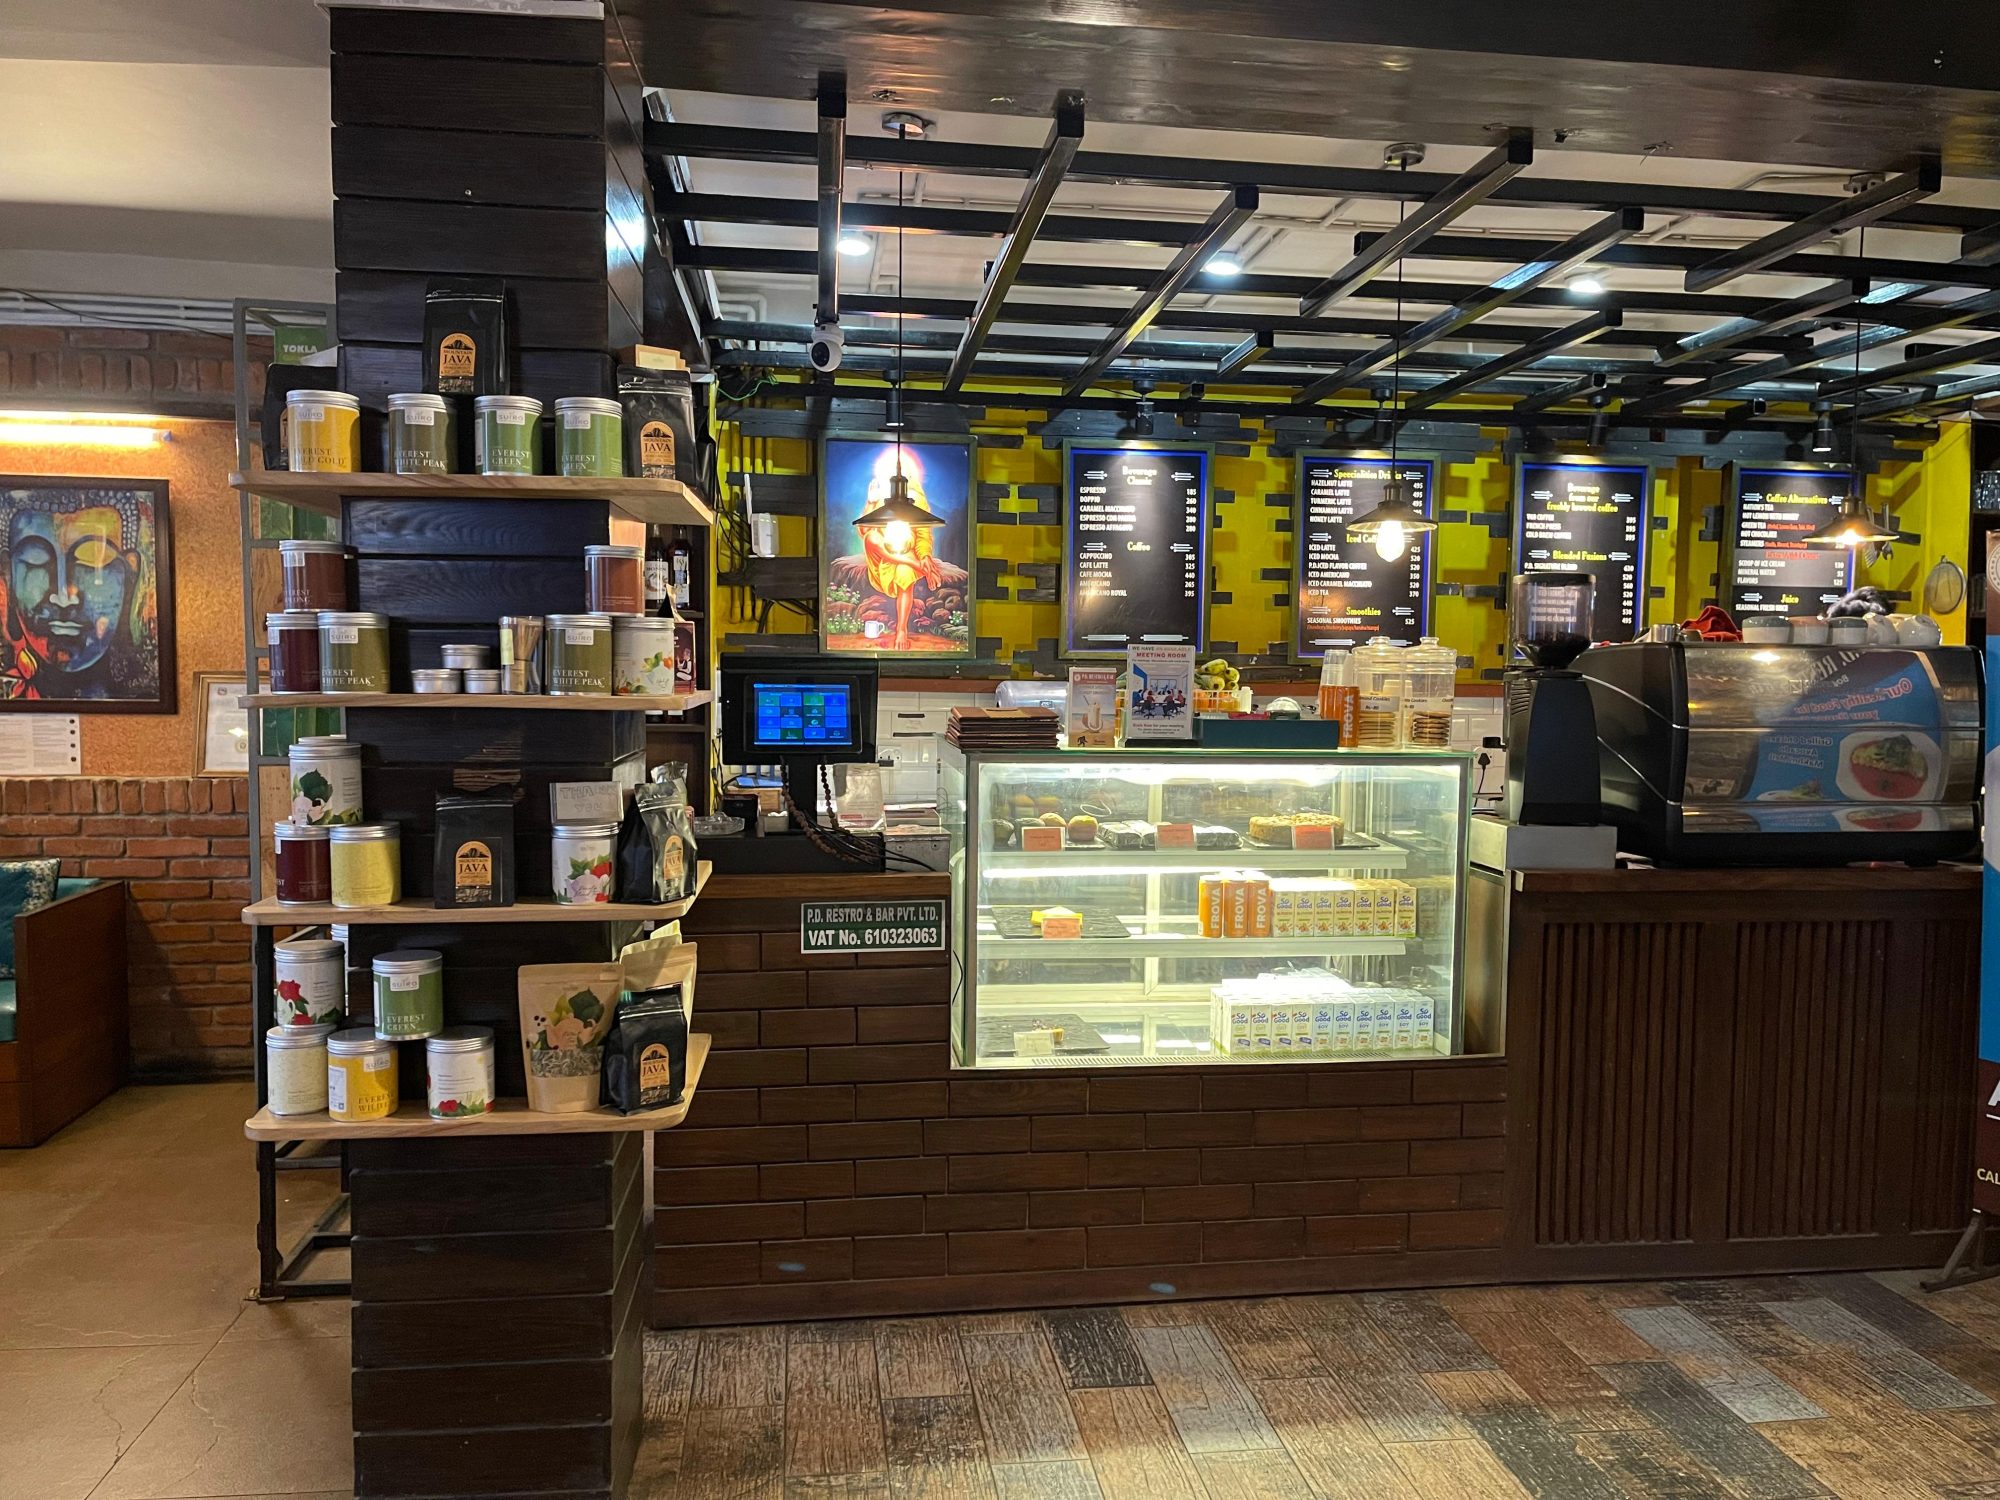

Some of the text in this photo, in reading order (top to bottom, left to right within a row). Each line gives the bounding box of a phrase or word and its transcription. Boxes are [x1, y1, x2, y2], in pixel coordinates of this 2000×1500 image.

[443, 354, 472, 364] JAVA
[644, 443, 671, 452] JAVA
[492, 449, 530, 458] EVEREST
[492, 457, 522, 465] GREEN
[1311, 479, 1337, 487] HAZELNUT
[1766, 493, 1828, 504] Coffee Alternatives
[1338, 507, 1353, 515] LATTE
[1547, 501, 1618, 512] freshly brewed coffee
[1080, 514, 1105, 522] ESPRESSO
[1080, 523, 1105, 531] ESPRESSO
[1346, 533, 1361, 543] Iced
[1127, 541, 1151, 551] Coffee
[1080, 552, 1113, 560] CAPPUCCINO
[1552, 550, 1607, 560] Blended Fusions
[1781, 594, 1799, 603] Juice
[1346, 607, 1382, 616] Smoothies
[552, 669, 589, 677] EVEREST
[347, 677, 372, 685] PEAK
[552, 677, 604, 687] WHITE PEAK
[1343, 695, 1354, 738] FROVA
[459, 863, 488, 874] JAVA
[1210, 887, 1220, 929] FROVA
[1235, 887, 1245, 929] FROVA
[1256, 887, 1266, 929] FROVA
[807, 906, 939, 923] P.D. RESTRO & BAR PVT. LTD.
[808, 927, 937, 945] VAT No. 610323063
[386, 1013, 425, 1022] EVEREST
[641, 1062, 667, 1077] JAVA
